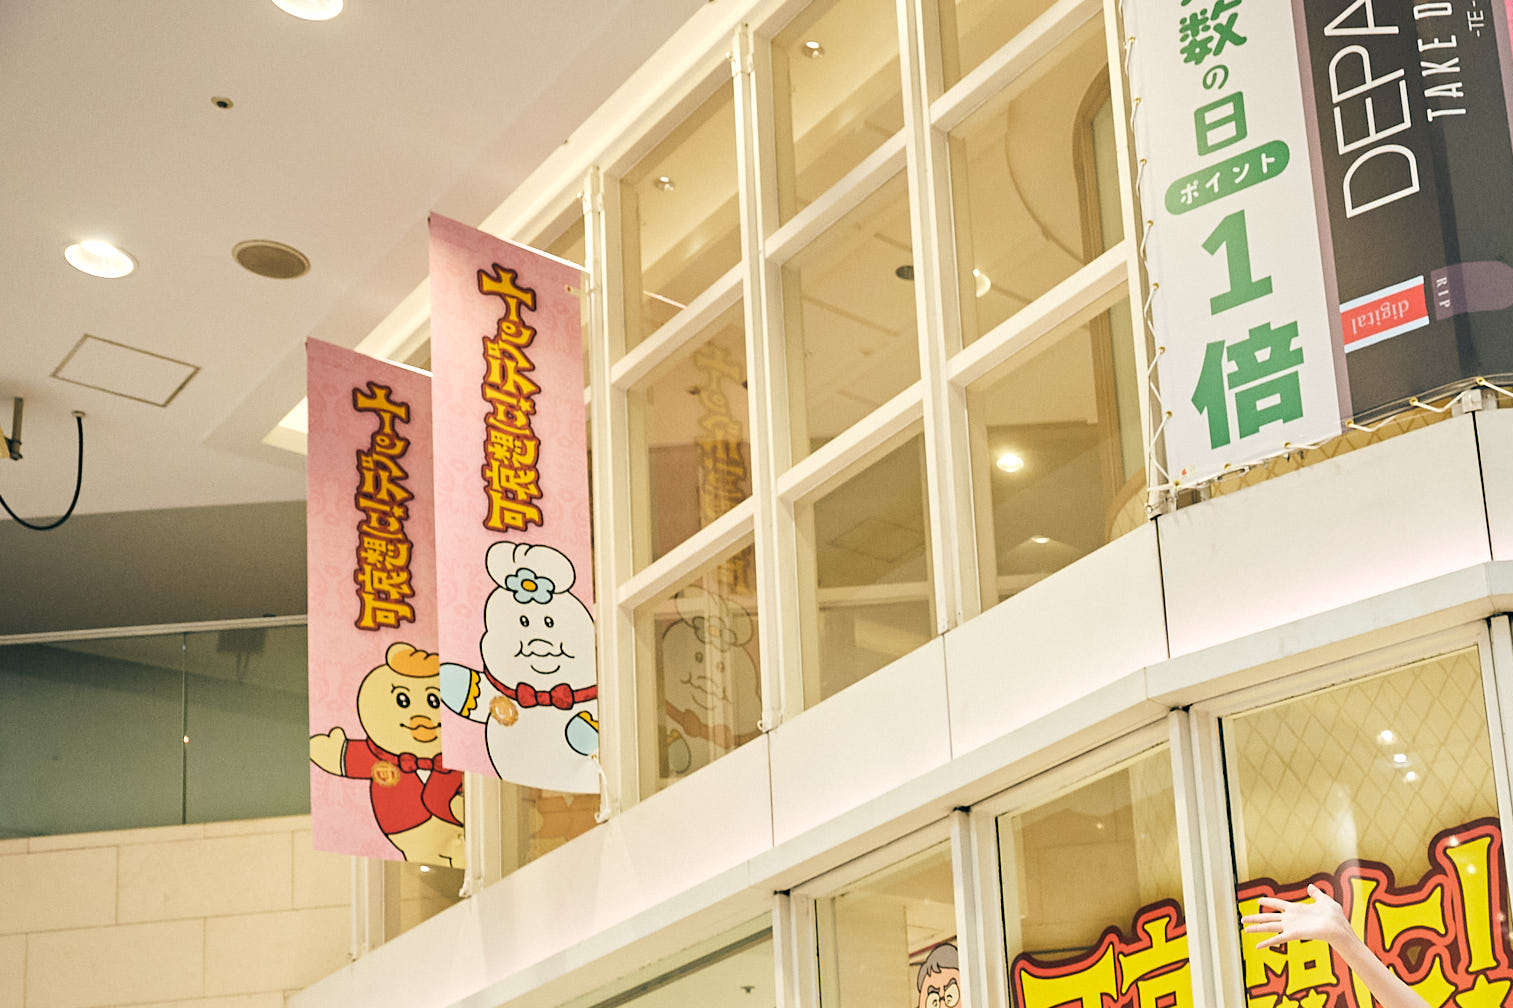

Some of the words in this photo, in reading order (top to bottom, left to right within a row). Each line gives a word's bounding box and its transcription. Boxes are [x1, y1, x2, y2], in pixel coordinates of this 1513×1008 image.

[1417, 35, 1466, 122] TAKE
[1179, 153, 1276, 206] ポイント
[1351, 299, 1410, 335] digital
[1436, 276, 1451, 308] RIP
[1191, 210, 1306, 450] 1倍
